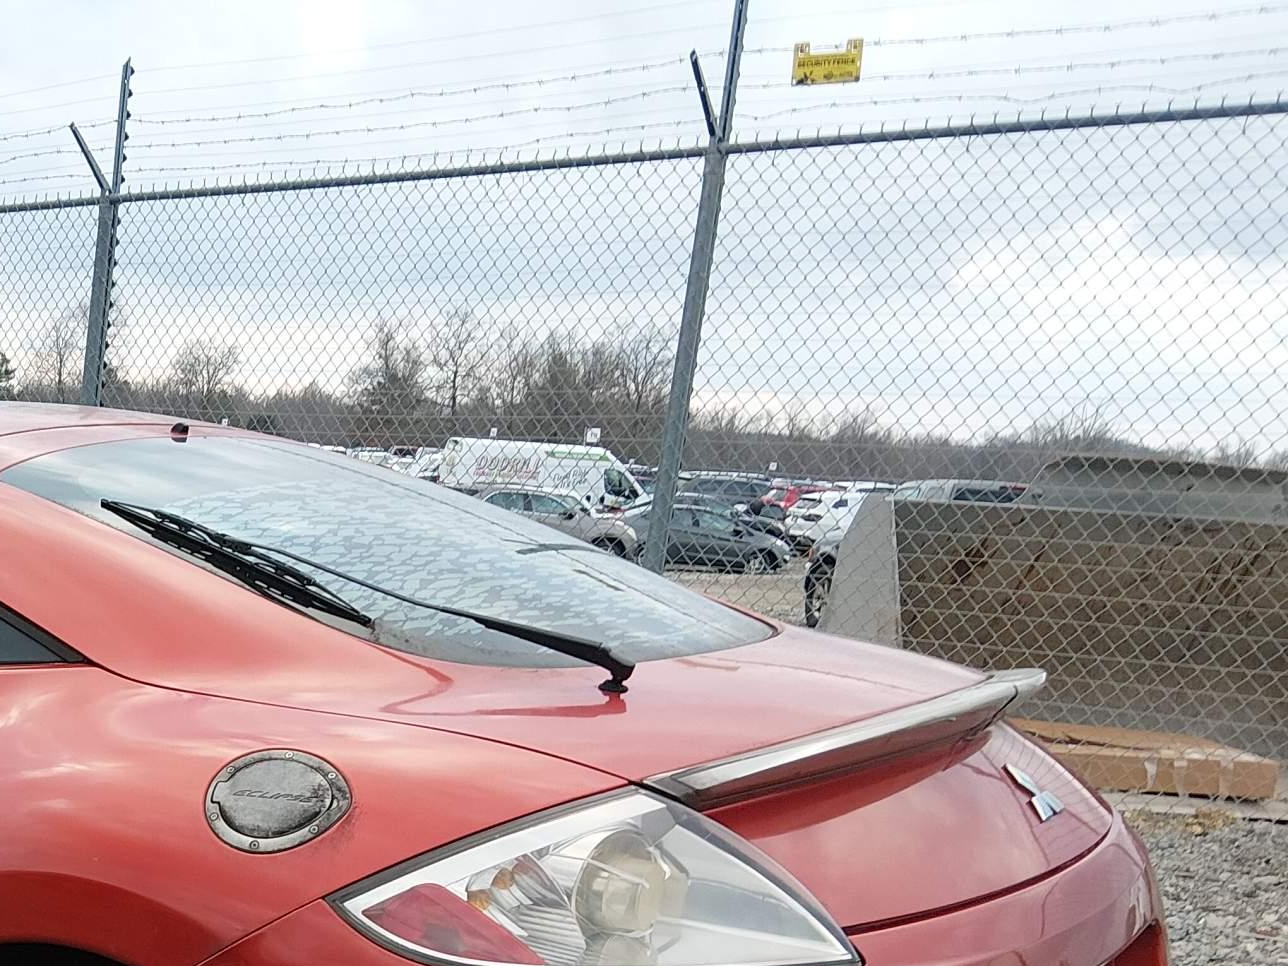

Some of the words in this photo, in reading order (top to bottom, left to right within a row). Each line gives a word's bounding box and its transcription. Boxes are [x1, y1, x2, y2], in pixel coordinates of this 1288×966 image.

[797, 59, 831, 68] SECURITY
[832, 57, 856, 66] FENCE
[476, 455, 541, 474] DODRILL
[232, 789, 320, 804] ECLIPSE
